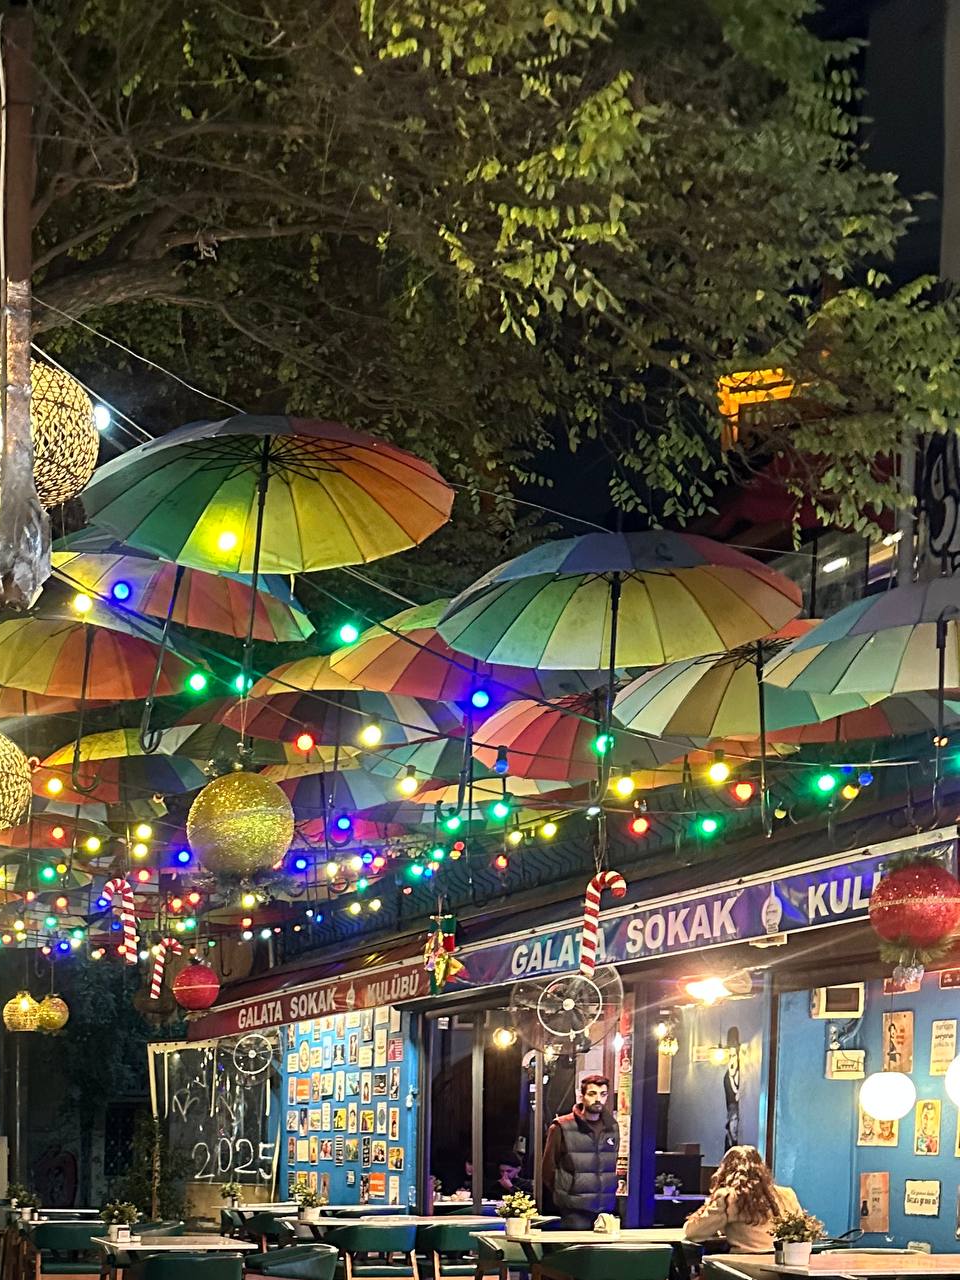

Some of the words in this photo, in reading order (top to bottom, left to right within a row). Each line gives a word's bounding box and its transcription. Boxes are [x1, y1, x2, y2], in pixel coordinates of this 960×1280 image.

[511, 927, 607, 976] GALAA
[625, 896, 739, 954] SOKAK
[808, 864, 884, 920] KUL
[238, 1000, 283, 1029] GALATA
[290, 987, 338, 1019] SOKAK
[367, 970, 420, 1006] KULÜBÜ
[191, 1137, 275, 1180] 2025
